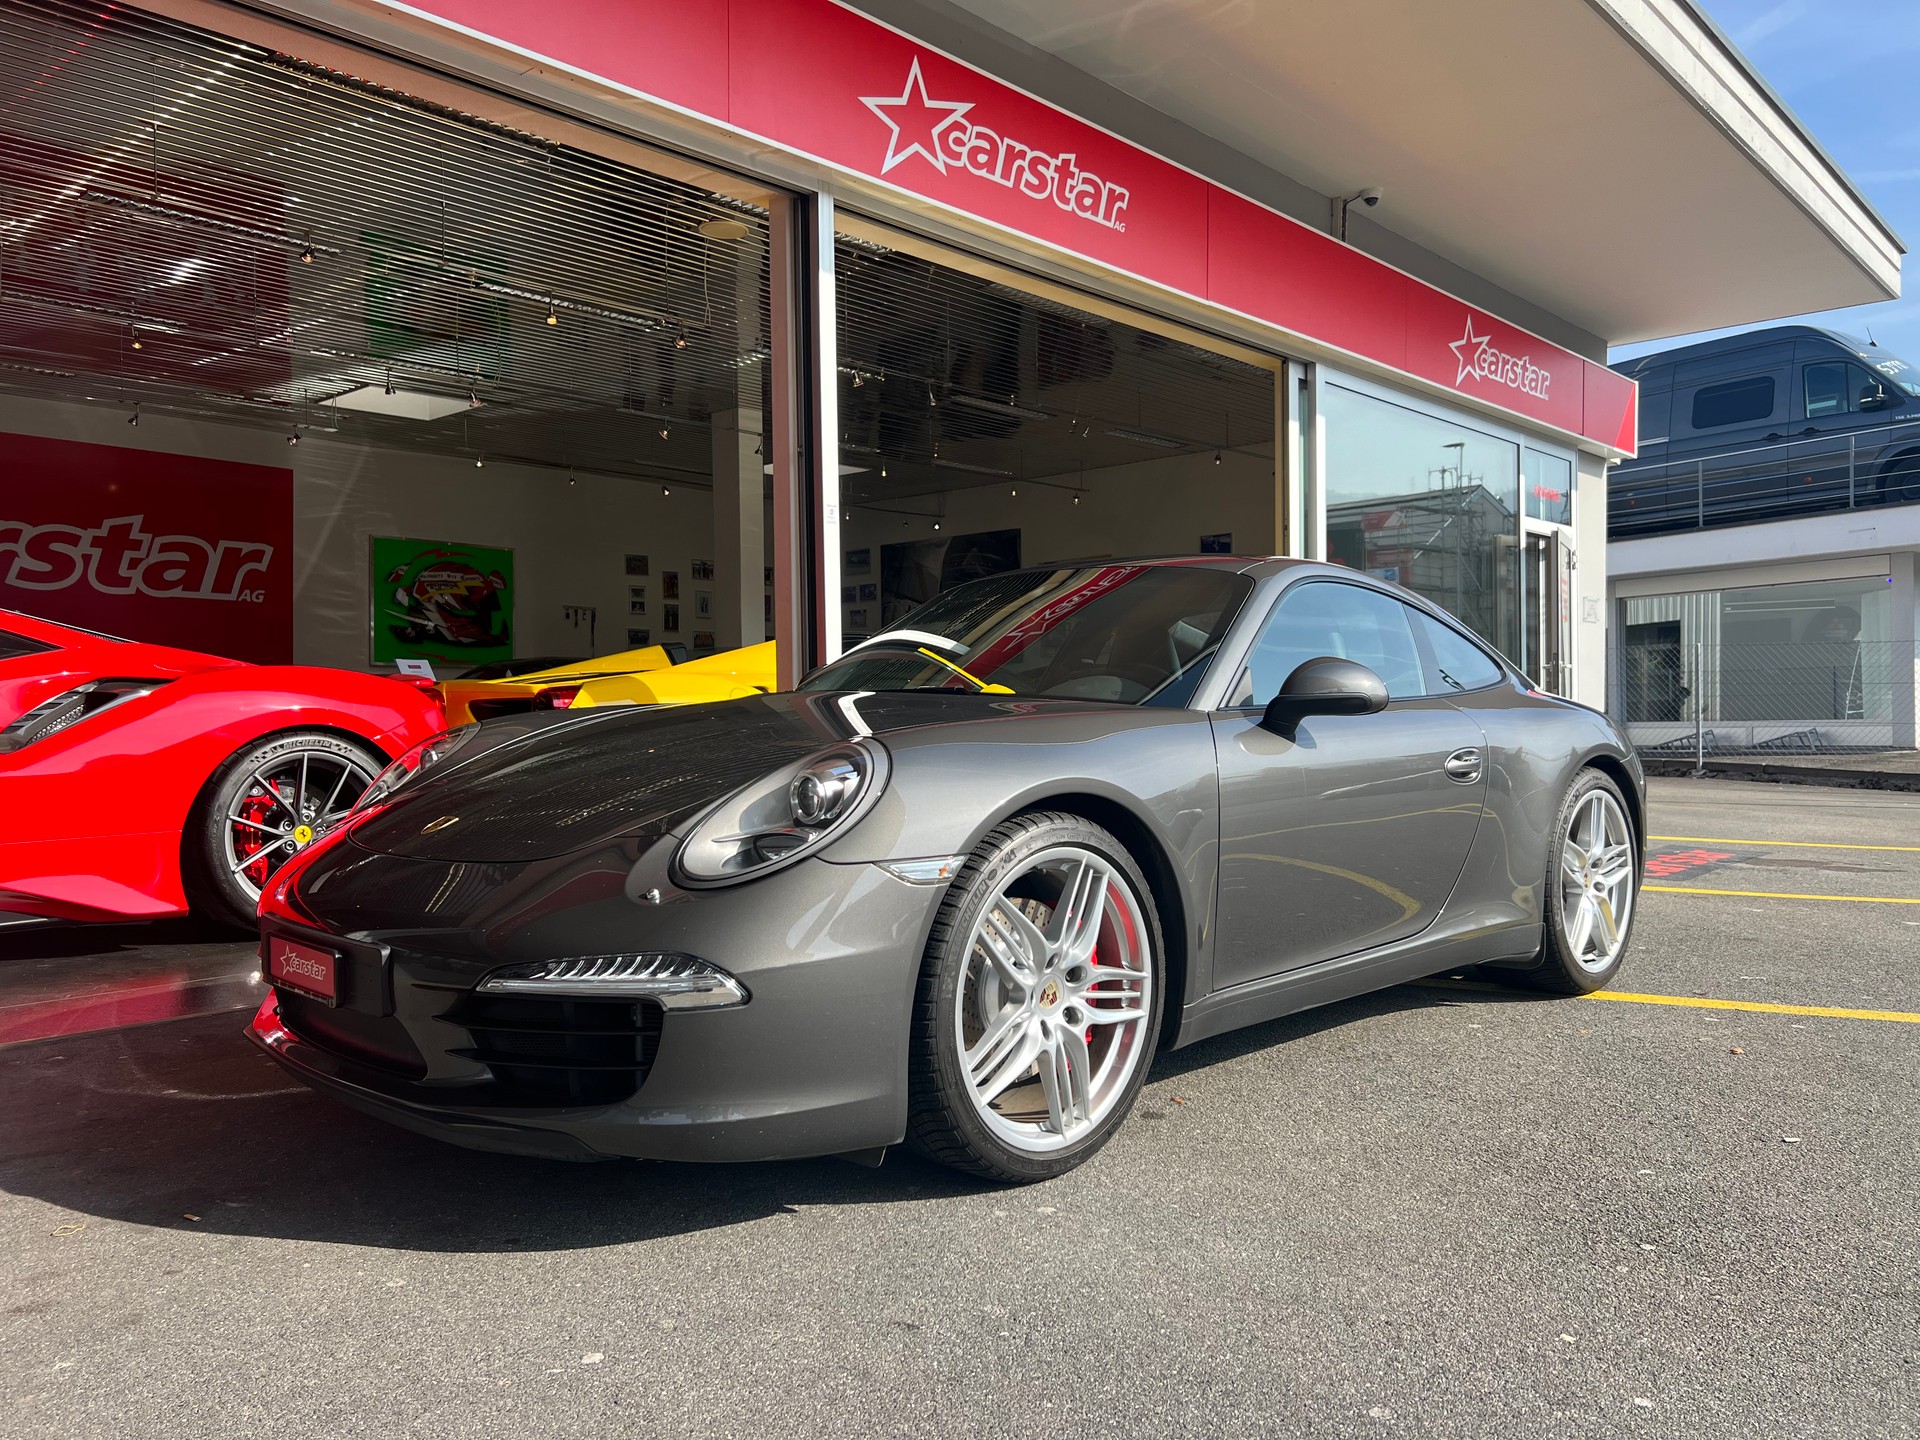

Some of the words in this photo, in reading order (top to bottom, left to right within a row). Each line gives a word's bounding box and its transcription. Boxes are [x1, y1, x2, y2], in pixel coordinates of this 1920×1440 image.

[933, 115, 1130, 228] carstar
[1113, 220, 1126, 233] AG
[1474, 346, 1550, 398] carstar
[238, 589, 266, 603] AG
[283, 738, 332, 750] MICHELIN
[290, 956, 326, 980] carstar
